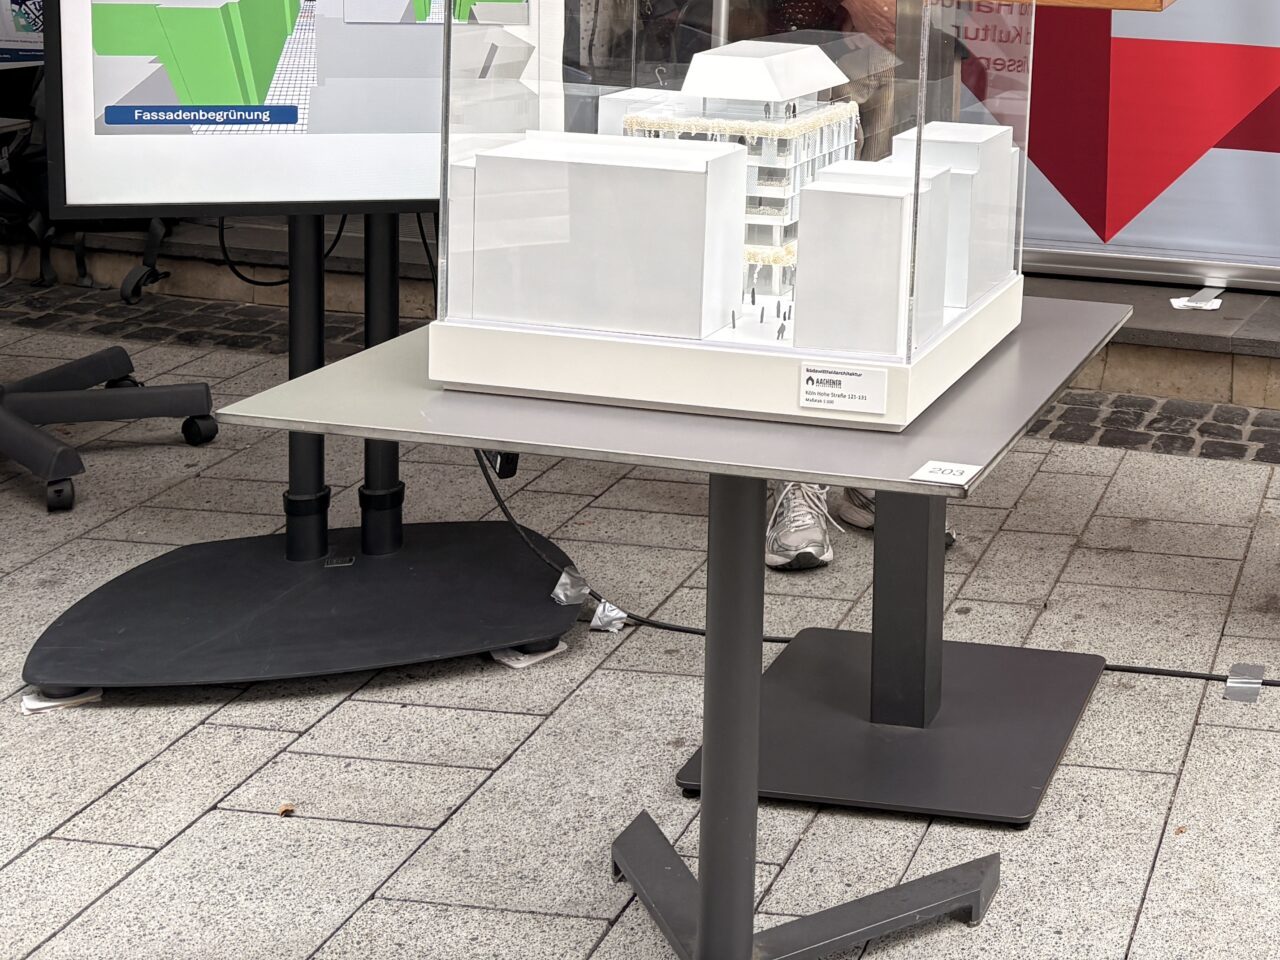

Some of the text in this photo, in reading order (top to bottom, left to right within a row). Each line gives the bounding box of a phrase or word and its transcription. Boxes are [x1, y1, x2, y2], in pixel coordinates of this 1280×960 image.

[134, 109, 271, 122] Fassadenbegrünung
[815, 378, 842, 386] AACHENER
[928, 467, 965, 477] 203
